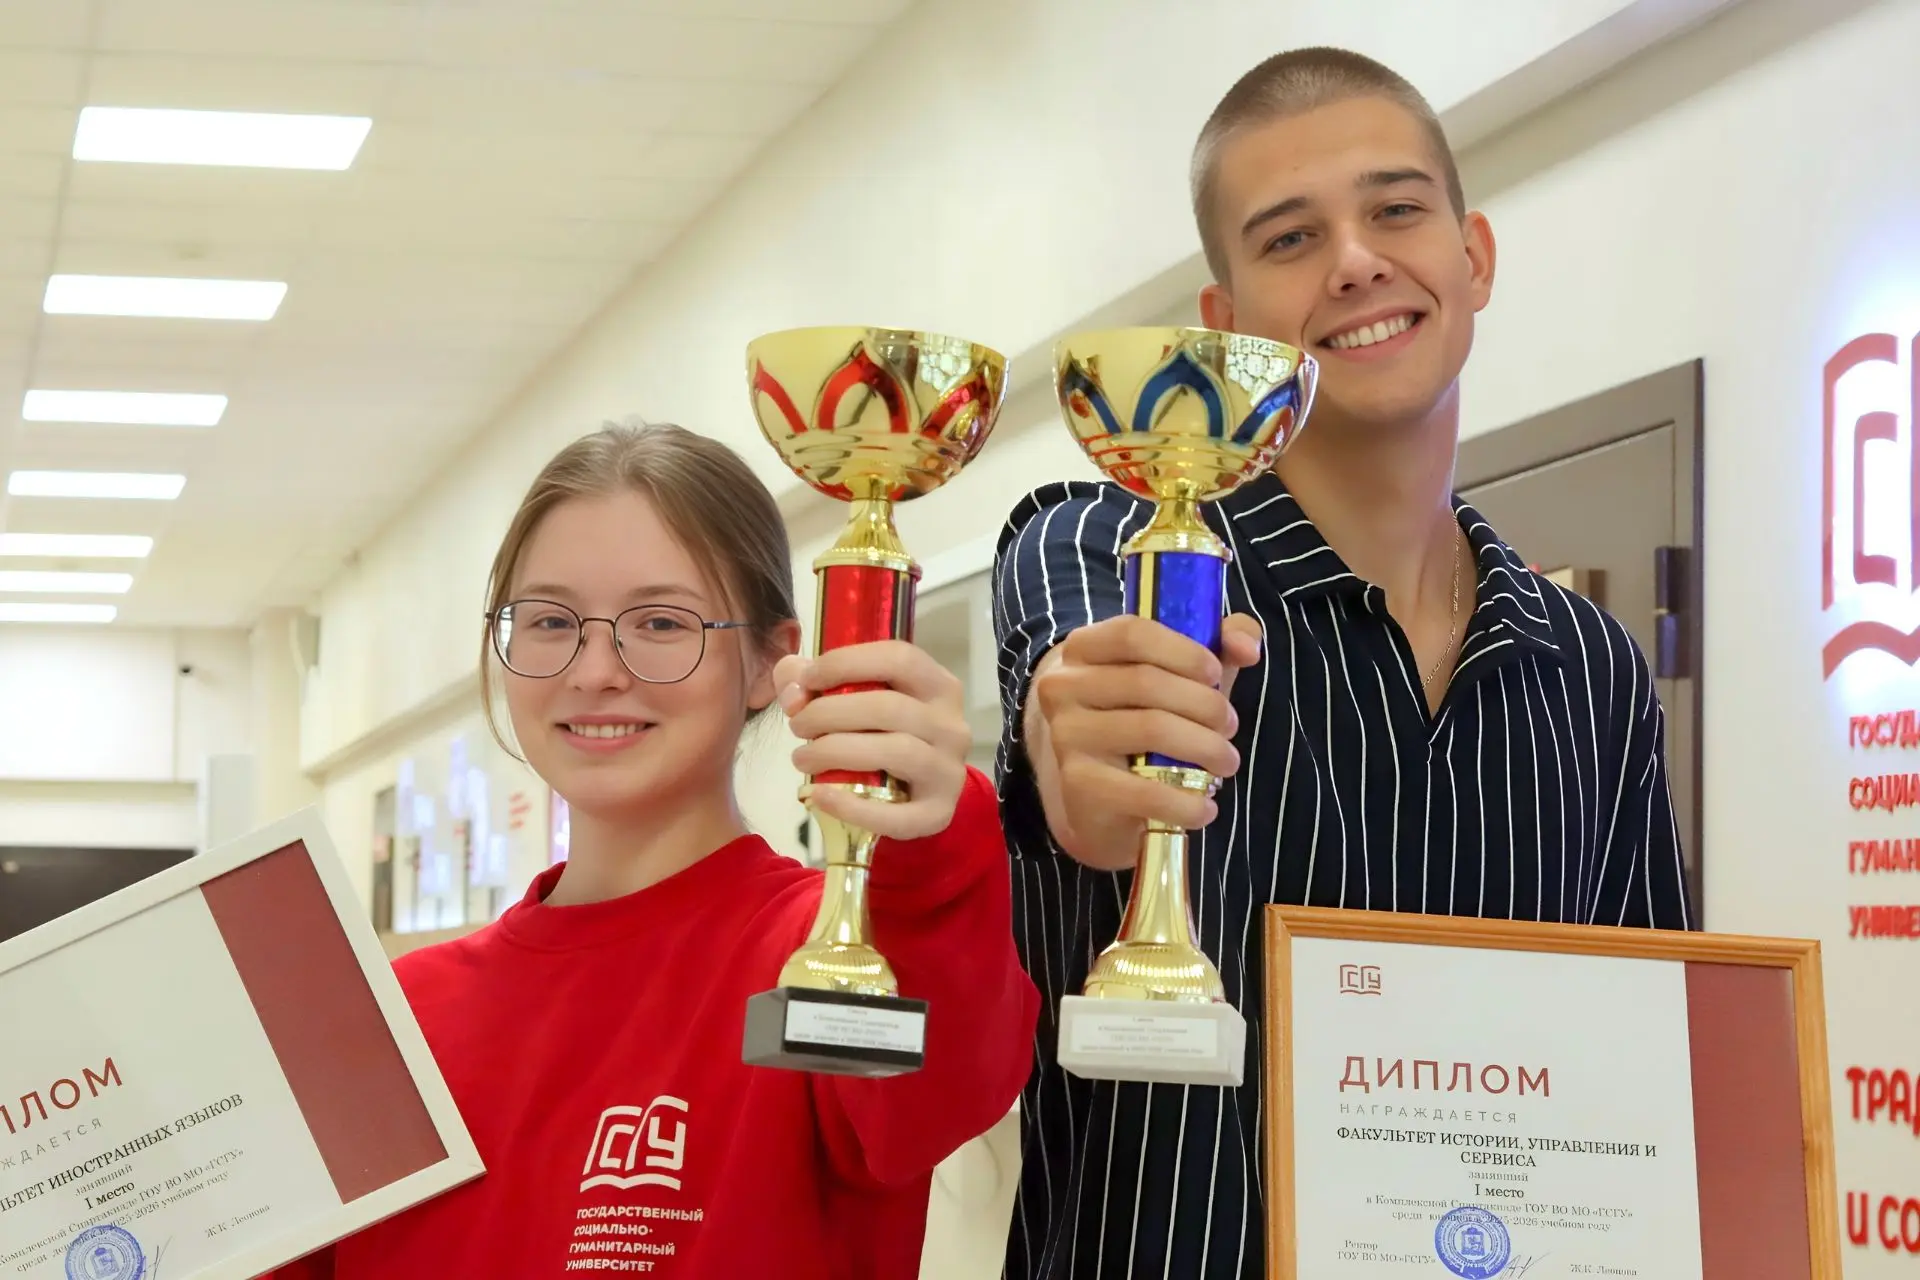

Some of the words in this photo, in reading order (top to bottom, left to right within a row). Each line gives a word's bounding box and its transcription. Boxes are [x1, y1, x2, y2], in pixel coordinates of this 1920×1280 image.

[1849, 709, 1920, 750] ГОСУД
[1339, 1056, 1550, 1097] ДИПЛОМ
[1340, 1103, 1517, 1123] НАГРАЖДАЕТСЯ
[48, 1125, 173, 1190] ИНОСТРАННЫХ
[175, 1093, 243, 1133] ЯЗЫКОВ
[1337, 1127, 1436, 1144] ФАКУЛЬТЕТ
[1440, 1132, 1524, 1150] ИСТОРИИ,
[1528, 1137, 1639, 1156] УПРАВЛЕНИЯ
[1645, 1145, 1657, 1157] И
[1460, 1151, 1536, 1167] СЕРВИСА
[96, 1182, 135, 1206] место
[1485, 1187, 1524, 1198] место
[577, 1206, 704, 1222] ГОСУДАРСТВЕННЫЙ
[1552, 1205, 1567, 1214] ВО
[1572, 1206, 1590, 1216] МО
[574, 1223, 653, 1237] СОЦИАЛЬНО-
[569, 1241, 675, 1256] ГУМАНИТАРНЫЙ
[566, 1258, 654, 1272] УНИВЕРСИТЕТ
